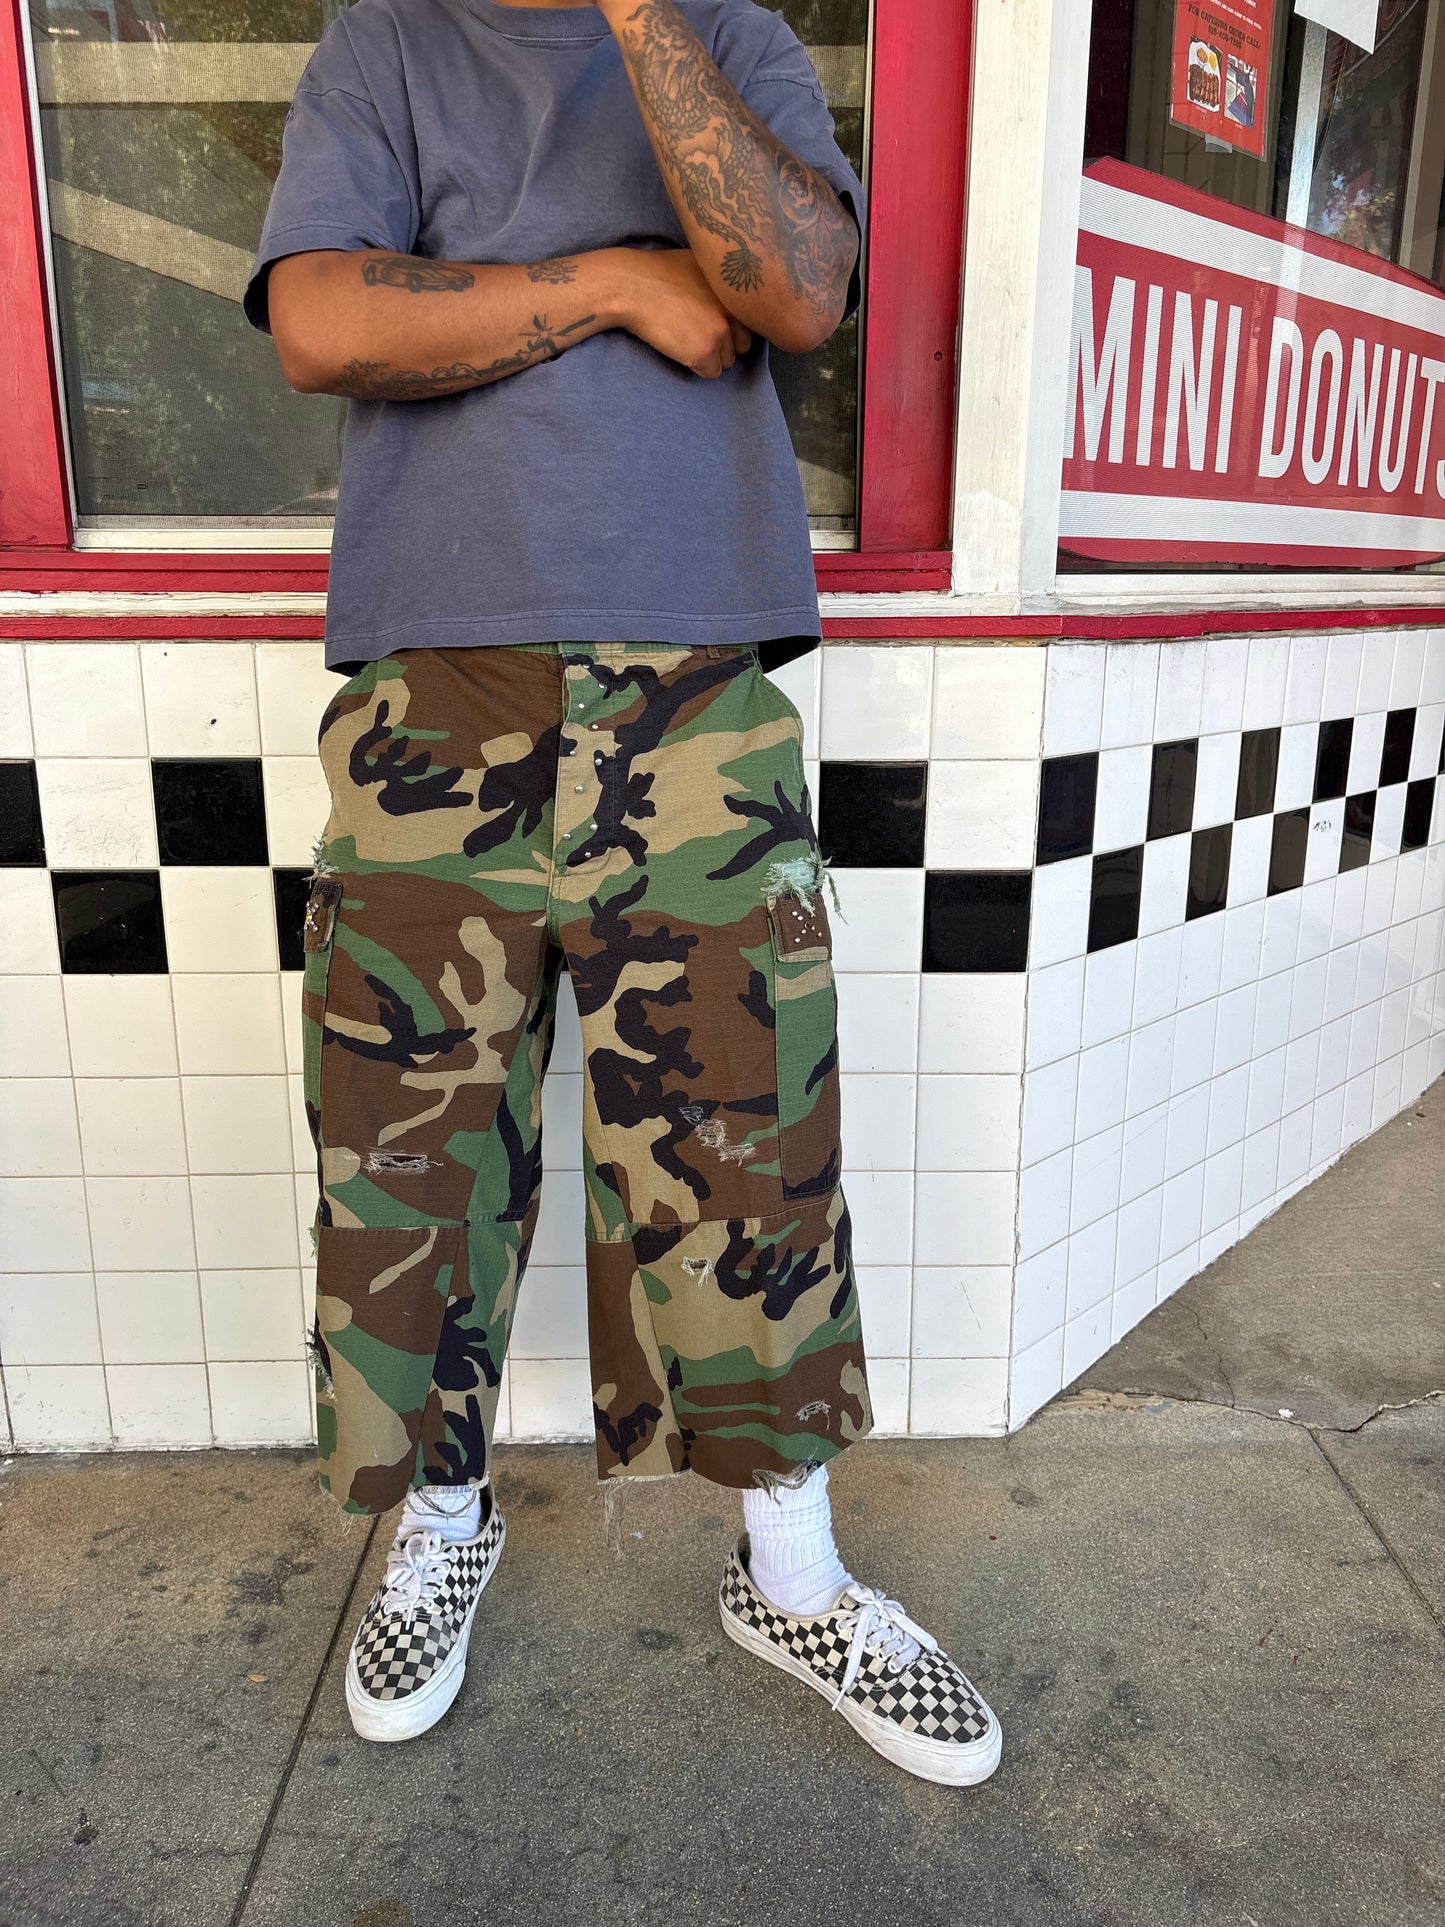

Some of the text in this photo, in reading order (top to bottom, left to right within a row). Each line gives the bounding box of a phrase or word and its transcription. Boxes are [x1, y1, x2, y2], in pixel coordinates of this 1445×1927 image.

[1188, 4, 1200, 17] FOR
[1062, 264, 1445, 500] MINI DONUT
